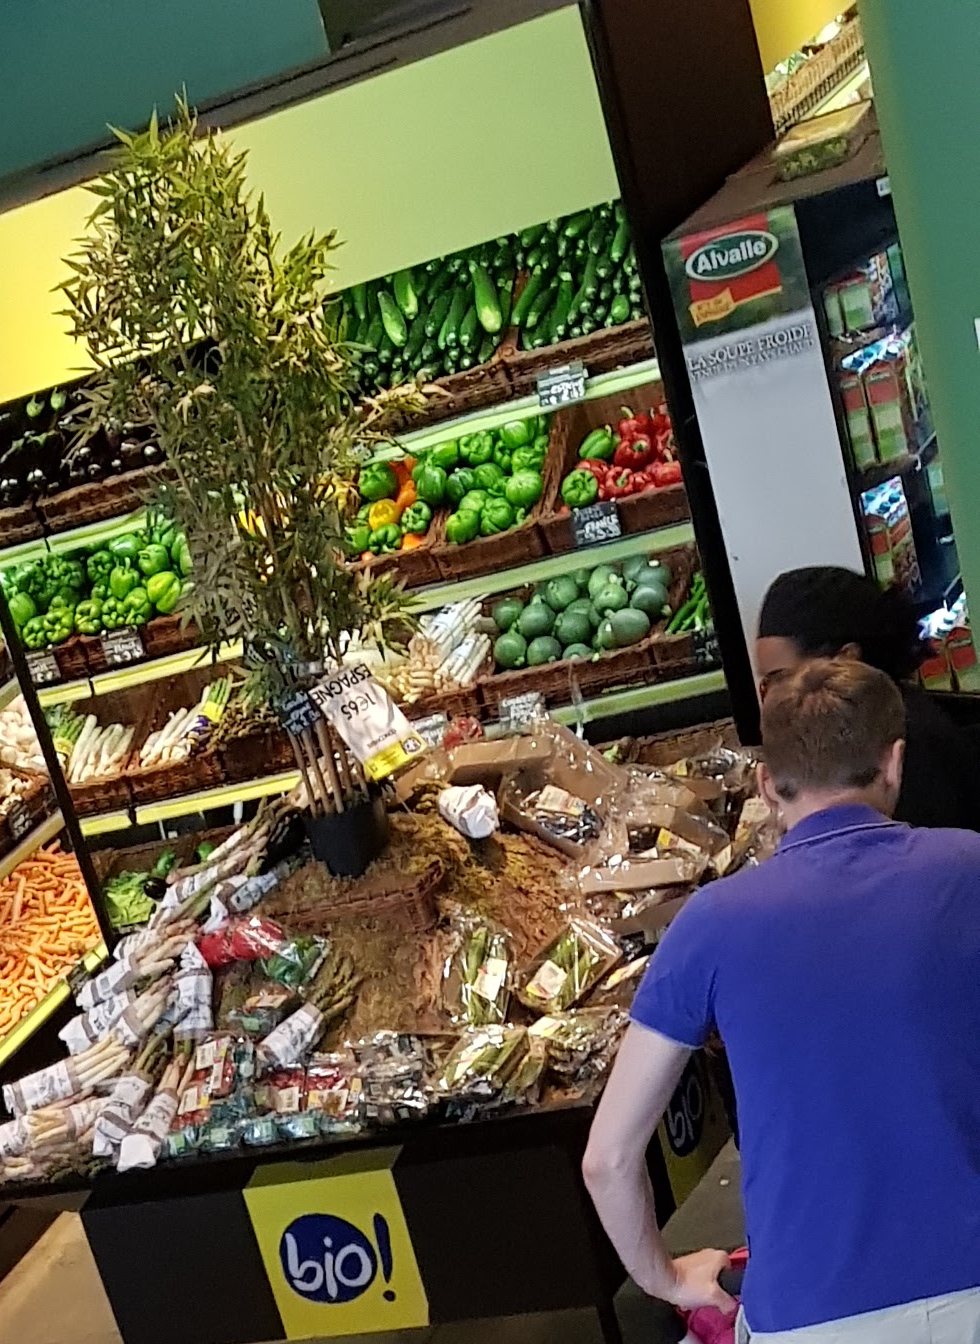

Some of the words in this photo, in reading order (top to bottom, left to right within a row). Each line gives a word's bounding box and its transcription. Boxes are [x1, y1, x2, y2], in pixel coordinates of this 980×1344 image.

[696, 238, 768, 274] Alvalle
[688, 353, 708, 370] LA
[708, 340, 754, 365] SOUPE
[756, 323, 812, 351] FROIDE
[309, 664, 372, 705] ESPAGNE
[341, 692, 376, 721] 1€65
[284, 1212, 397, 1303] bio!
